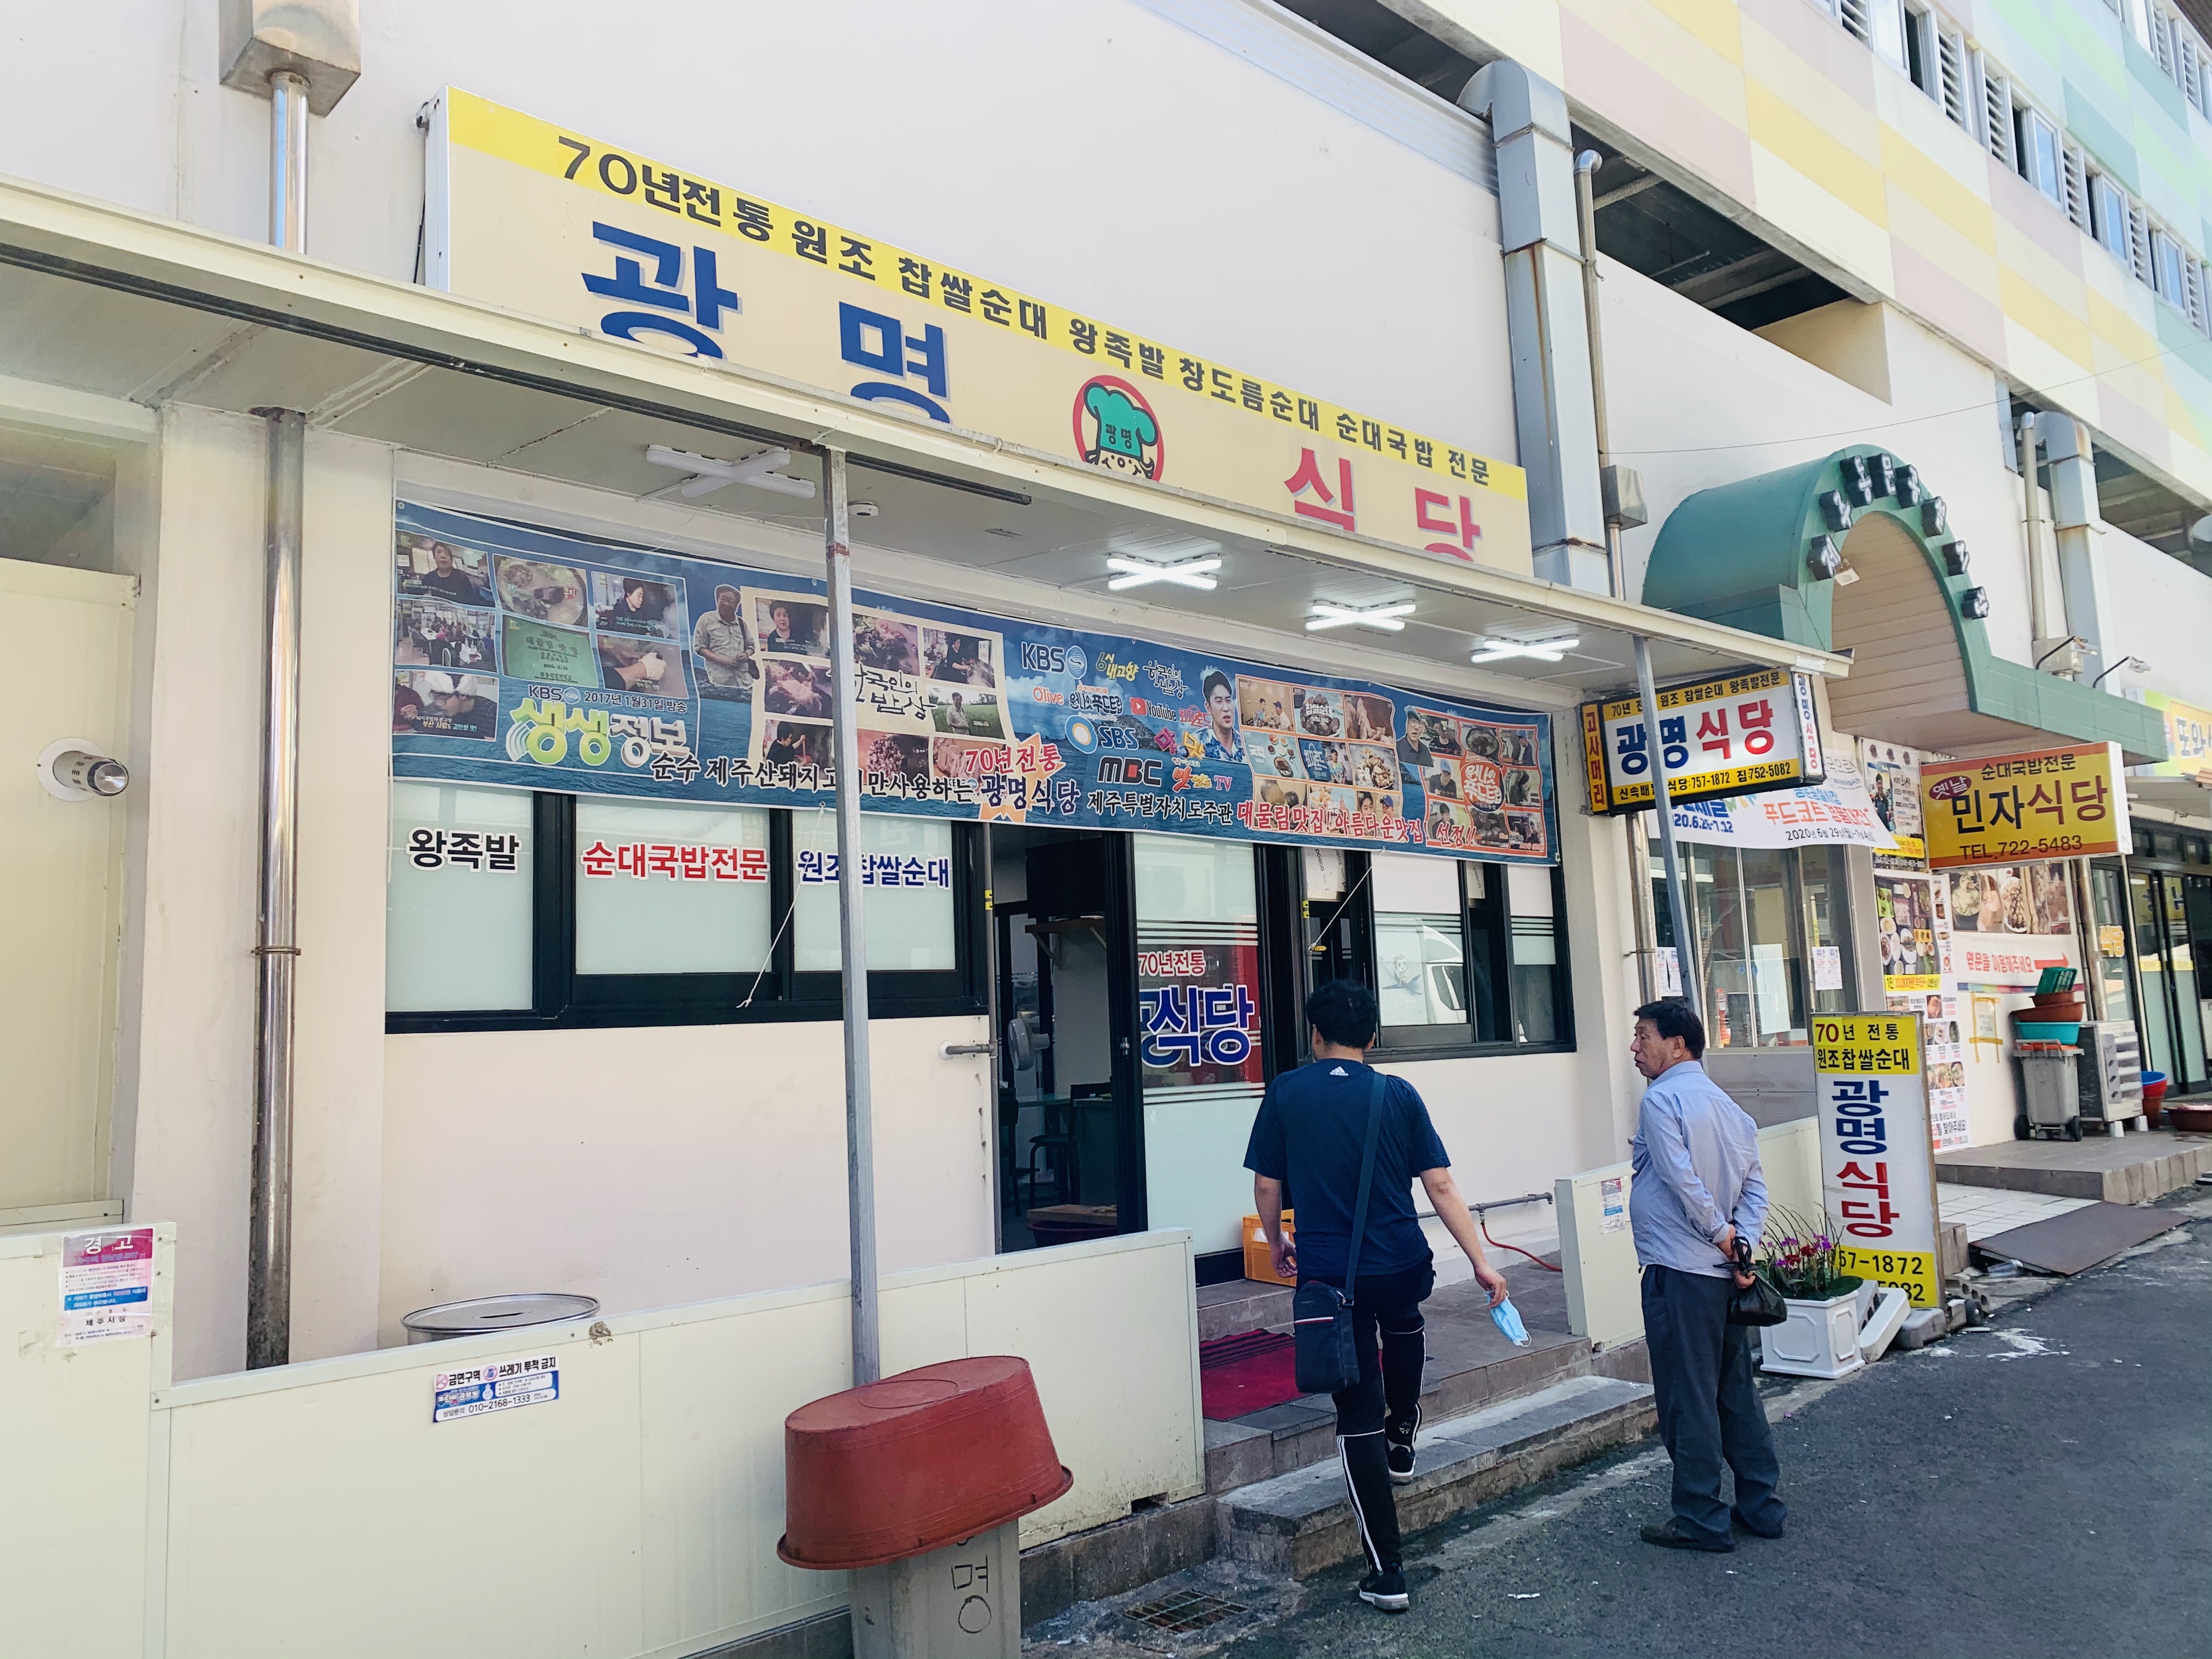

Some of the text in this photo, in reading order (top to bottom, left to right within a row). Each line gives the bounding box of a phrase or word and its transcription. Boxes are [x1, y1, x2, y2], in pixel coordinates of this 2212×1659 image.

[791, 220, 876, 281] 원조
[898, 257, 1047, 341] 찹쌀순대
[1069, 318, 1165, 380] 왕족발
[1180, 357, 1319, 432] 창도름순대
[1336, 413, 1434, 469] 순대국밥
[1447, 449, 1490, 486] 전문
[1105, 423, 1133, 450] 광명
[1022, 641, 1065, 674] KBS
[1106, 661, 1139, 682] 내고향
[528, 685, 687, 713] KBS 2017년 1월31일 방송
[870, 692, 938, 721] 밥상
[1146, 699, 1177, 722] YouTube
[1611, 702, 1631, 717] 70년
[1660, 692, 1679, 707] 원조
[510, 698, 690, 768] 생생정보
[1098, 725, 1139, 751] SBS
[2176, 715, 2212, 761] 또와
[1097, 755, 1163, 787] MBC
[1172, 766, 1233, 793] 맛있는 TV
[1980, 753, 2076, 781] 순대국밥전문
[651, 751, 701, 783] 순수
[980, 773, 1081, 815] 광명식당
[1932, 775, 1967, 799] 옛날
[1763, 800, 1830, 825] 푸드코트
[1951, 775, 2108, 834] 민자식당
[1786, 828, 1816, 841] 2020년
[1959, 834, 2084, 860] TEL.722-5483
[409, 828, 520, 871] 왕족발
[582, 840, 768, 881] 순대국밥전문
[1314, 848, 1324, 872] posco
[1472, 867, 1482, 889] posco
[1138, 950, 1206, 976] 70년전통
[1148, 985, 1255, 1066] 식당
[1815, 1021, 1900, 1043] 70년 전통
[1817, 1047, 1910, 1071] 원조찹쌀순대
[1831, 1079, 1900, 1238] 광명식당
[84, 1234, 134, 1255] 경고
[85, 1316, 126, 1327] 제주시장
[448, 1369, 481, 1386] 금연구역
[499, 1362, 522, 1378] 쓰레기
[524, 1359, 539, 1372] 투척
[541, 1356, 556, 1370] 금지
[443, 1407, 465, 1418] 상담문의
[468, 1394, 531, 1414] 010-2168-1333
[951, 1536, 992, 1634] 명
